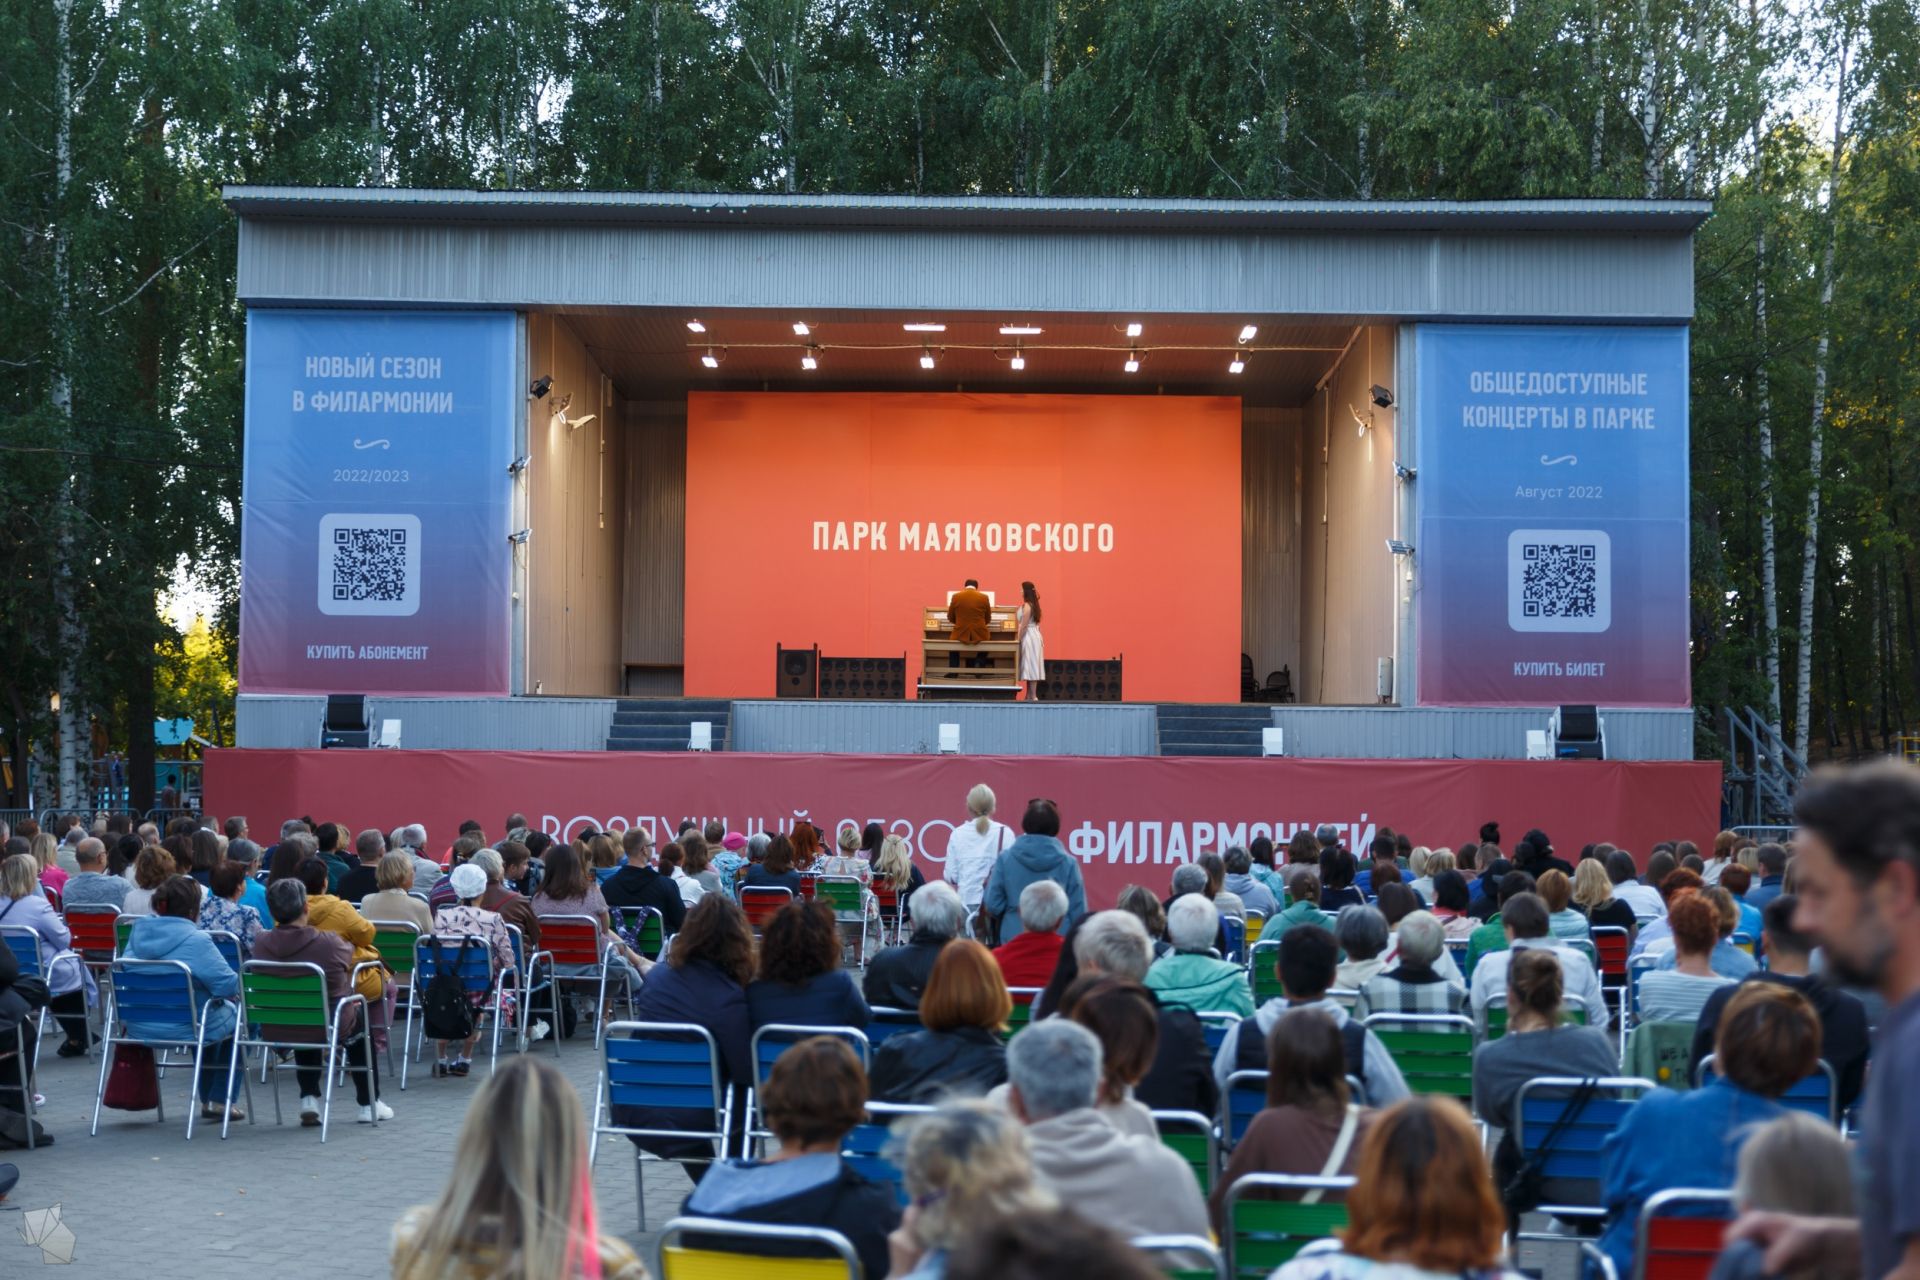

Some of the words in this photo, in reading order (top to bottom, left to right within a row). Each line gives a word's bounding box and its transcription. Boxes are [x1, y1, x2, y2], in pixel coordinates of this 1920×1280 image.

[305, 352, 375, 379] НОВЫЙ
[380, 357, 442, 379] СЕЗОН
[1470, 371, 1649, 396] ОБЩЕДОСТУПНЫЕ
[292, 391, 305, 412] В
[310, 390, 453, 414] ФИЛАРМОНИИ
[1462, 405, 1569, 431] КОНЦЕРТЫ
[1574, 407, 1587, 429] В
[1592, 407, 1656, 430] ПАРКЕ
[332, 469, 410, 483] 2022/2023
[1514, 485, 1563, 502] Август
[1567, 485, 1604, 499] 2022
[812, 521, 888, 551] ПАРК
[899, 522, 1115, 553] МАЯКОВСКОГО
[306, 645, 356, 660] КУПИТЬ
[358, 645, 429, 661] АБОНЕМЕНТ
[1513, 662, 1563, 677] КУПИТЬ
[1565, 662, 1606, 677] БИЛЕТ
